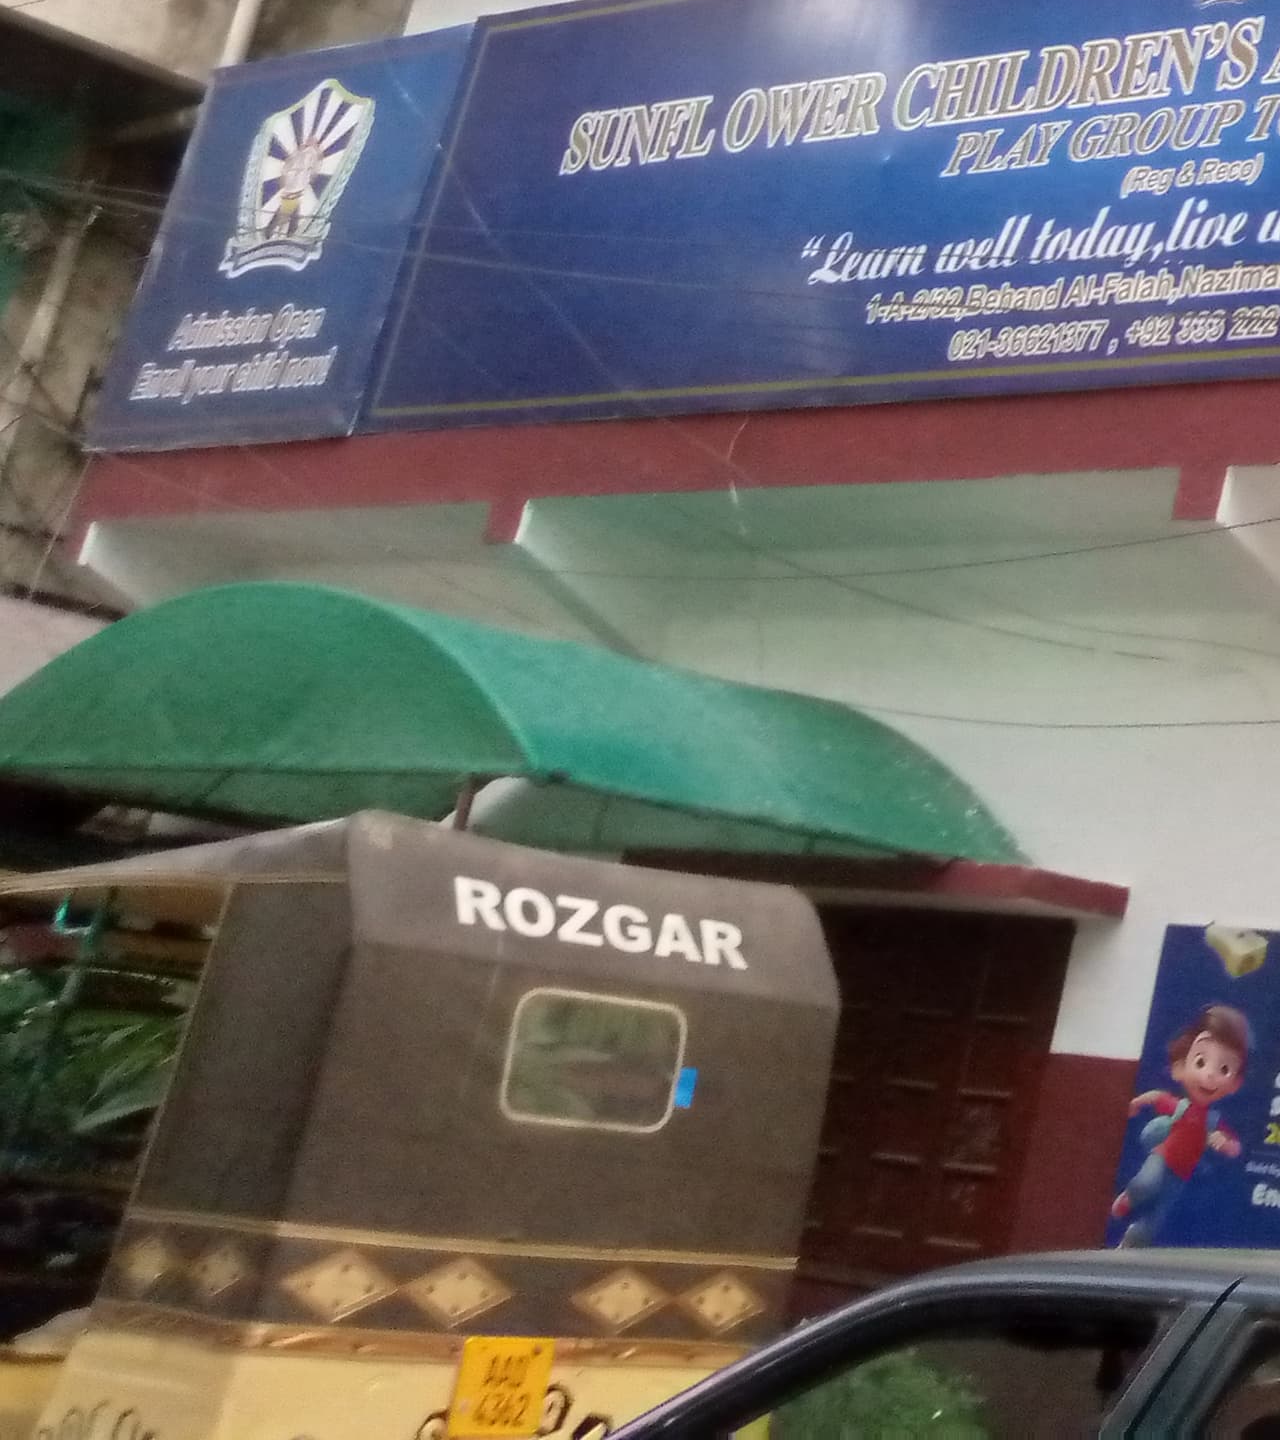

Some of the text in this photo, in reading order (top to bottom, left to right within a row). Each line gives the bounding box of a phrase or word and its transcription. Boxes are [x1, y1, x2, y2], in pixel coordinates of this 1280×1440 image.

[940, 121, 1072, 178] PLAY
[1068, 98, 1247, 160] GROUP
[1120, 151, 1265, 200] (Reg & Reco)
[934, 213, 1023, 274] well
[166, 303, 326, 352] Admission Open
[453, 875, 748, 971] ROZGAR
